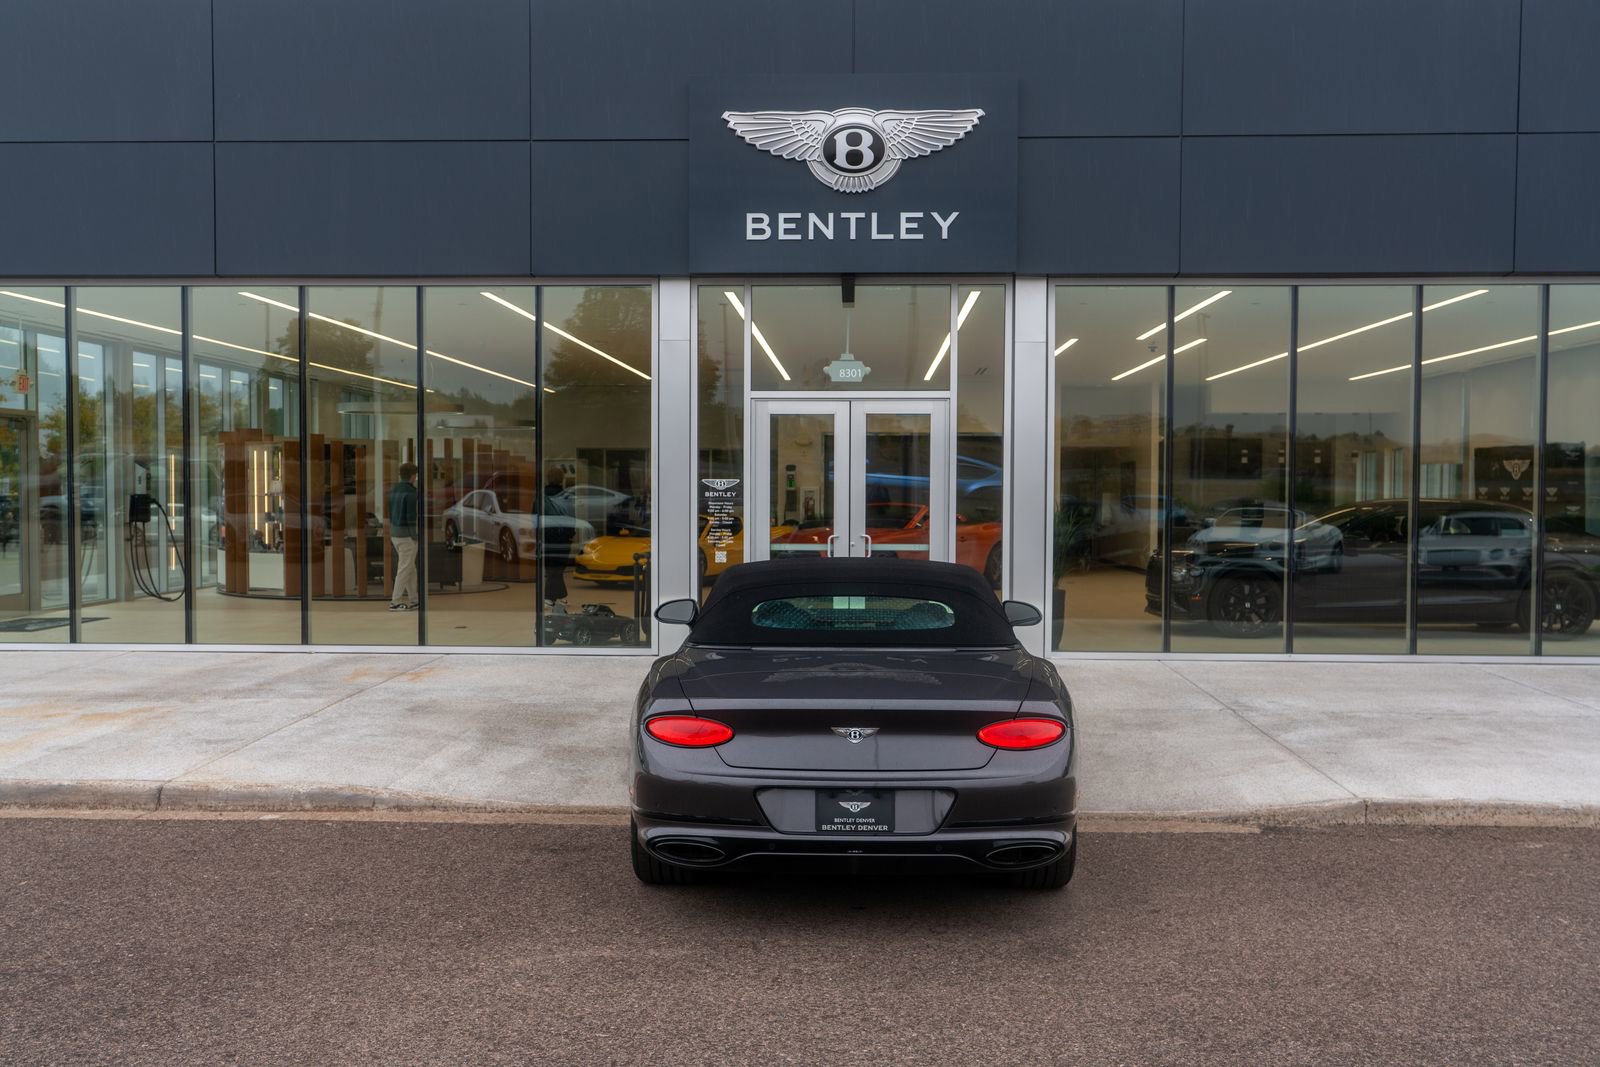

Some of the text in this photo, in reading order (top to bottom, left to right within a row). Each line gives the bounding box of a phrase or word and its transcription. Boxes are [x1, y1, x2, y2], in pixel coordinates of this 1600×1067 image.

[833, 131, 875, 170] B
[745, 211, 960, 241] BENTLEY
[839, 368, 862, 378] 8301
[850, 730, 859, 739] B
